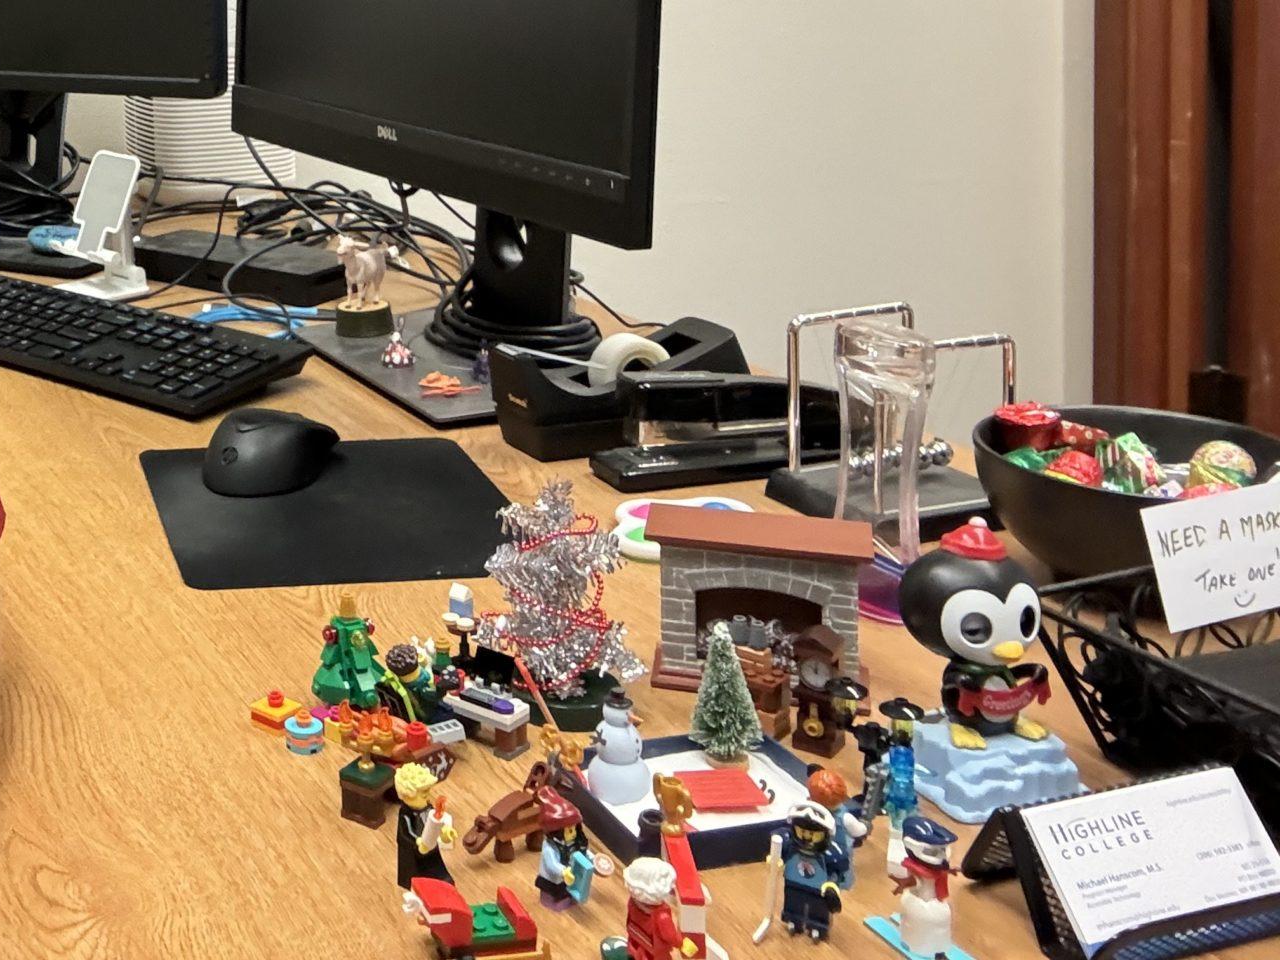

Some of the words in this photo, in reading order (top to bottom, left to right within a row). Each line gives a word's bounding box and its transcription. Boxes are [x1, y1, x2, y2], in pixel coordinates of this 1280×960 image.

[376, 125, 398, 142] DELL
[1157, 523, 1206, 558] NEED
[1219, 518, 1232, 542] A
[1048, 810, 1146, 845] HIGHLINE
[1061, 828, 1155, 860] COLLEGE
[1076, 876, 1108, 890] Michael
[1109, 868, 1148, 883] Hanscom,
[1146, 863, 1164, 874] M.S.
